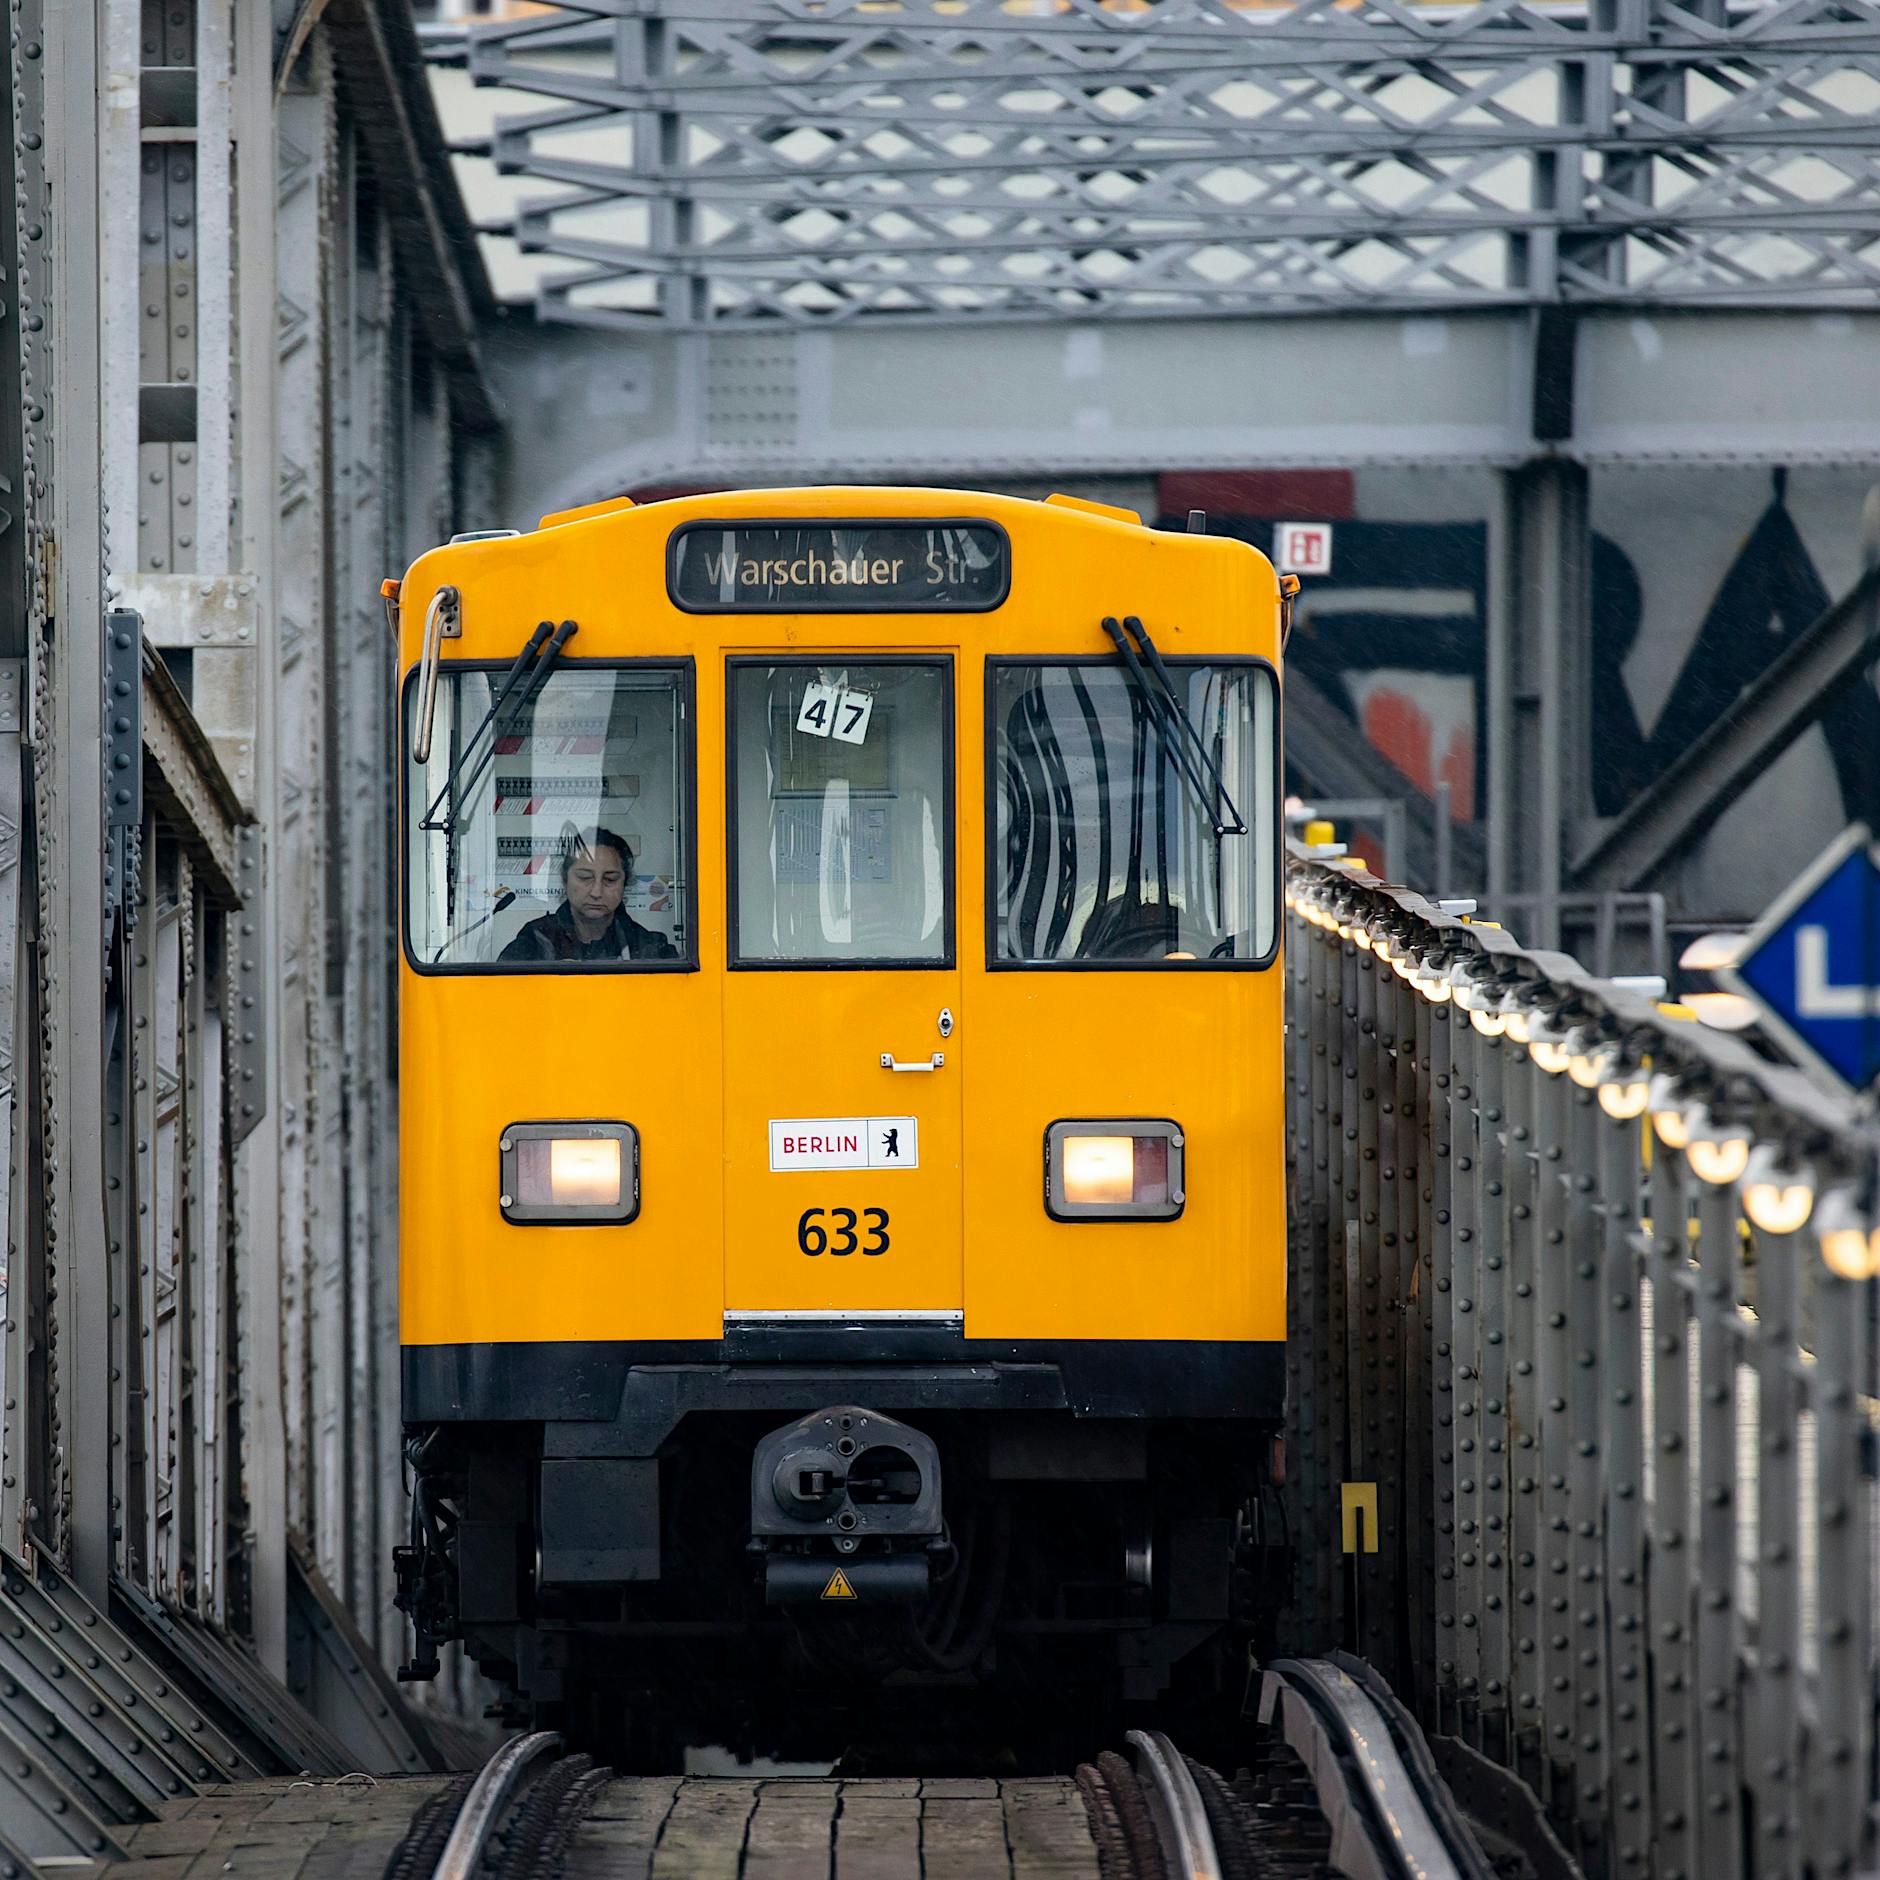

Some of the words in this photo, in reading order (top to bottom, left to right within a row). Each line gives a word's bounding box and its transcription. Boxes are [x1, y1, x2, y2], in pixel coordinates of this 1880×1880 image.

[705, 549, 903, 585] Warschauer
[926, 551, 979, 585] Str.
[783, 1136, 857, 1153] BERLIN
[797, 1207, 890, 1256] 633
